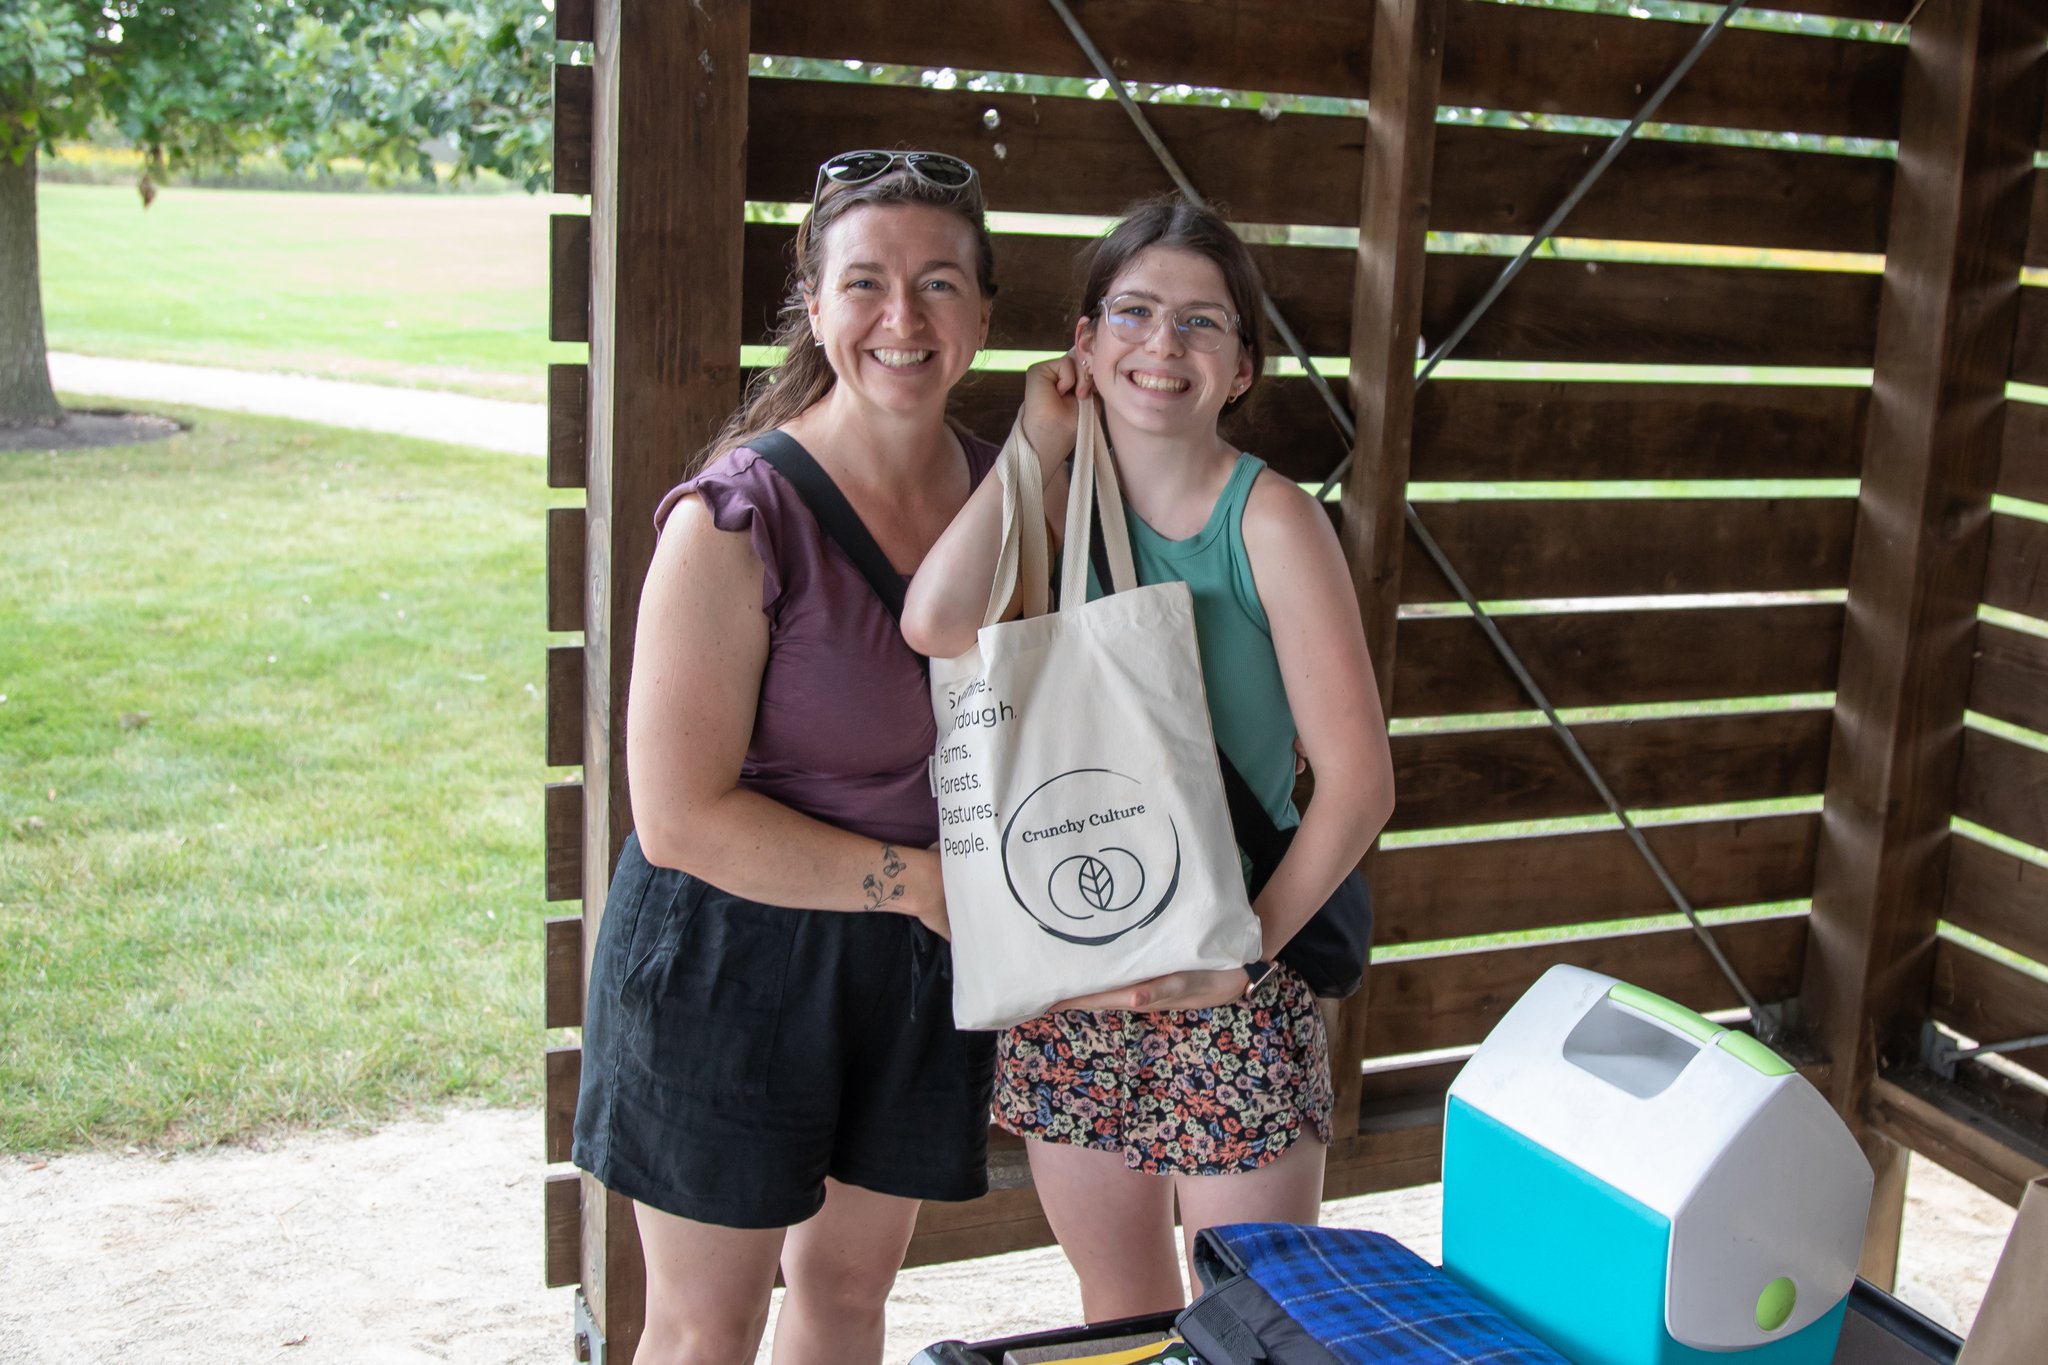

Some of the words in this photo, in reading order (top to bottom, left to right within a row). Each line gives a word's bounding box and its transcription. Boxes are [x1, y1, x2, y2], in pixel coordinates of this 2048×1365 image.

[949, 700, 1017, 734] rdough.
[940, 744, 972, 765] Farms.
[940, 772, 982, 796] Forests.
[941, 802, 999, 827] Pastures.
[1022, 818, 1086, 843] Crunchy
[1088, 804, 1146, 827] Culture
[944, 833, 989, 859] People.
